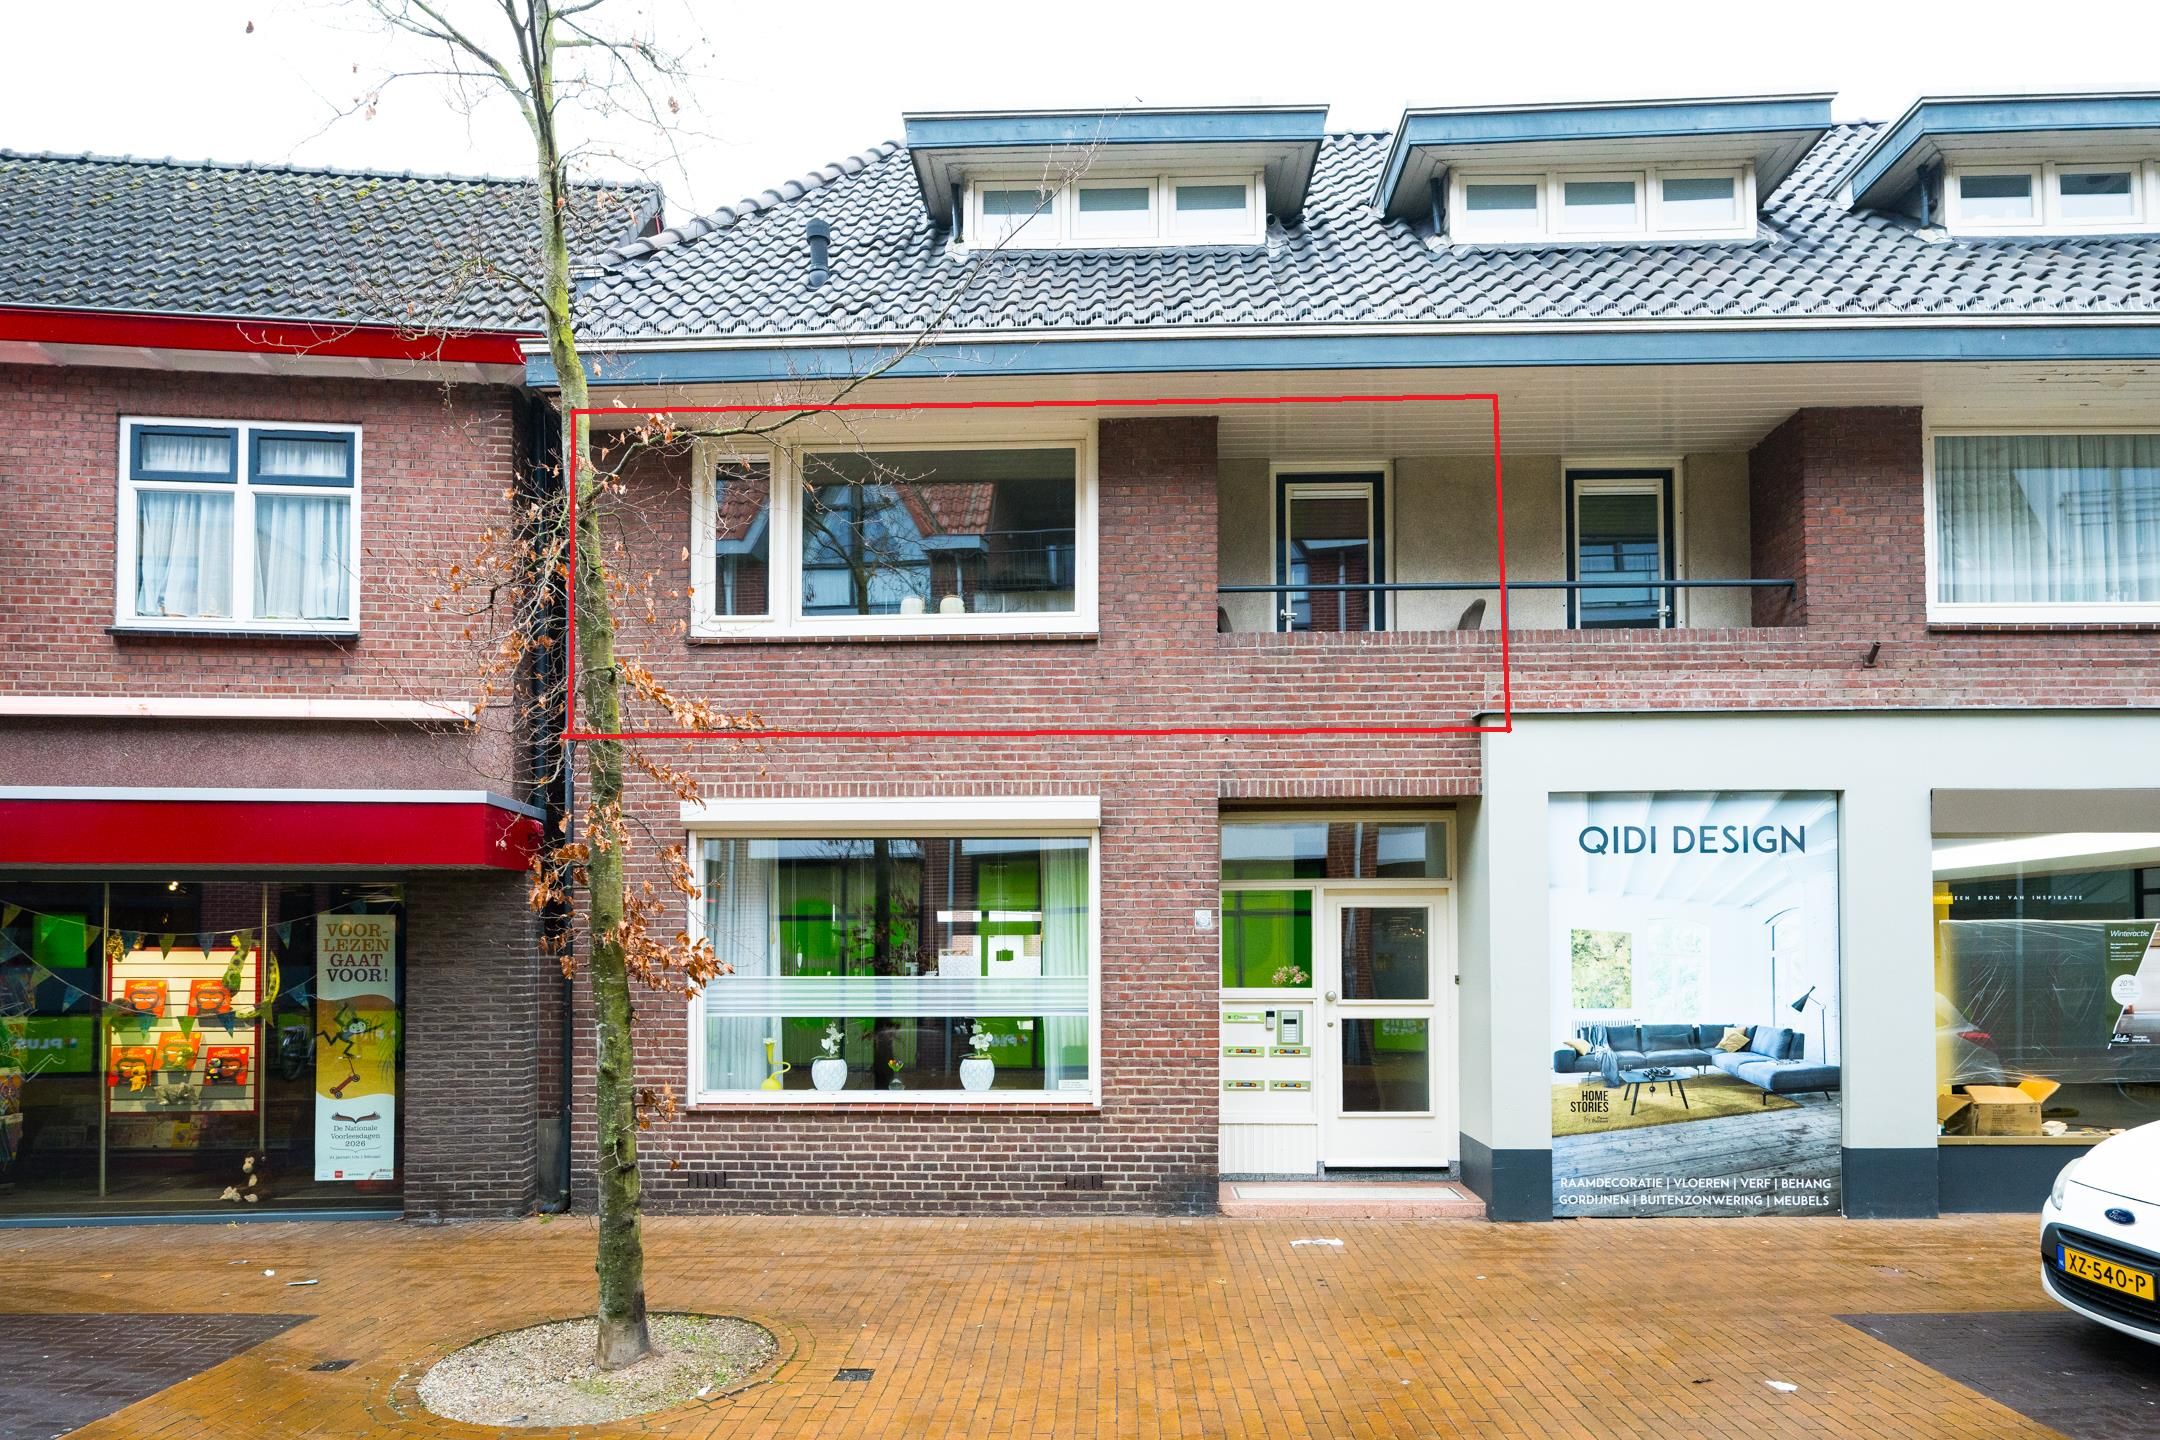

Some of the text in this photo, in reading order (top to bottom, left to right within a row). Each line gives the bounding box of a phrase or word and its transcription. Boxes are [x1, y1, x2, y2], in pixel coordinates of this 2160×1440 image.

[1578, 825, 1805, 855] QIDI DESIGN
[326, 923, 388, 937] VOOR-
[323, 938, 390, 952] LEZEN
[330, 953, 383, 967] GAAT
[326, 968, 388, 982] VOOR!
[1581, 1090, 1609, 1101] HOME
[1570, 1101, 1609, 1113] STORIES
[1560, 1178, 1832, 1189] RAAMDECORATIE VLOEREN VERF BEHANG
[1558, 1194, 1830, 1206] GORDIJNEN BUITENZONWERING MEUBELS
[2069, 1253, 2146, 1292] XZ-540-P
